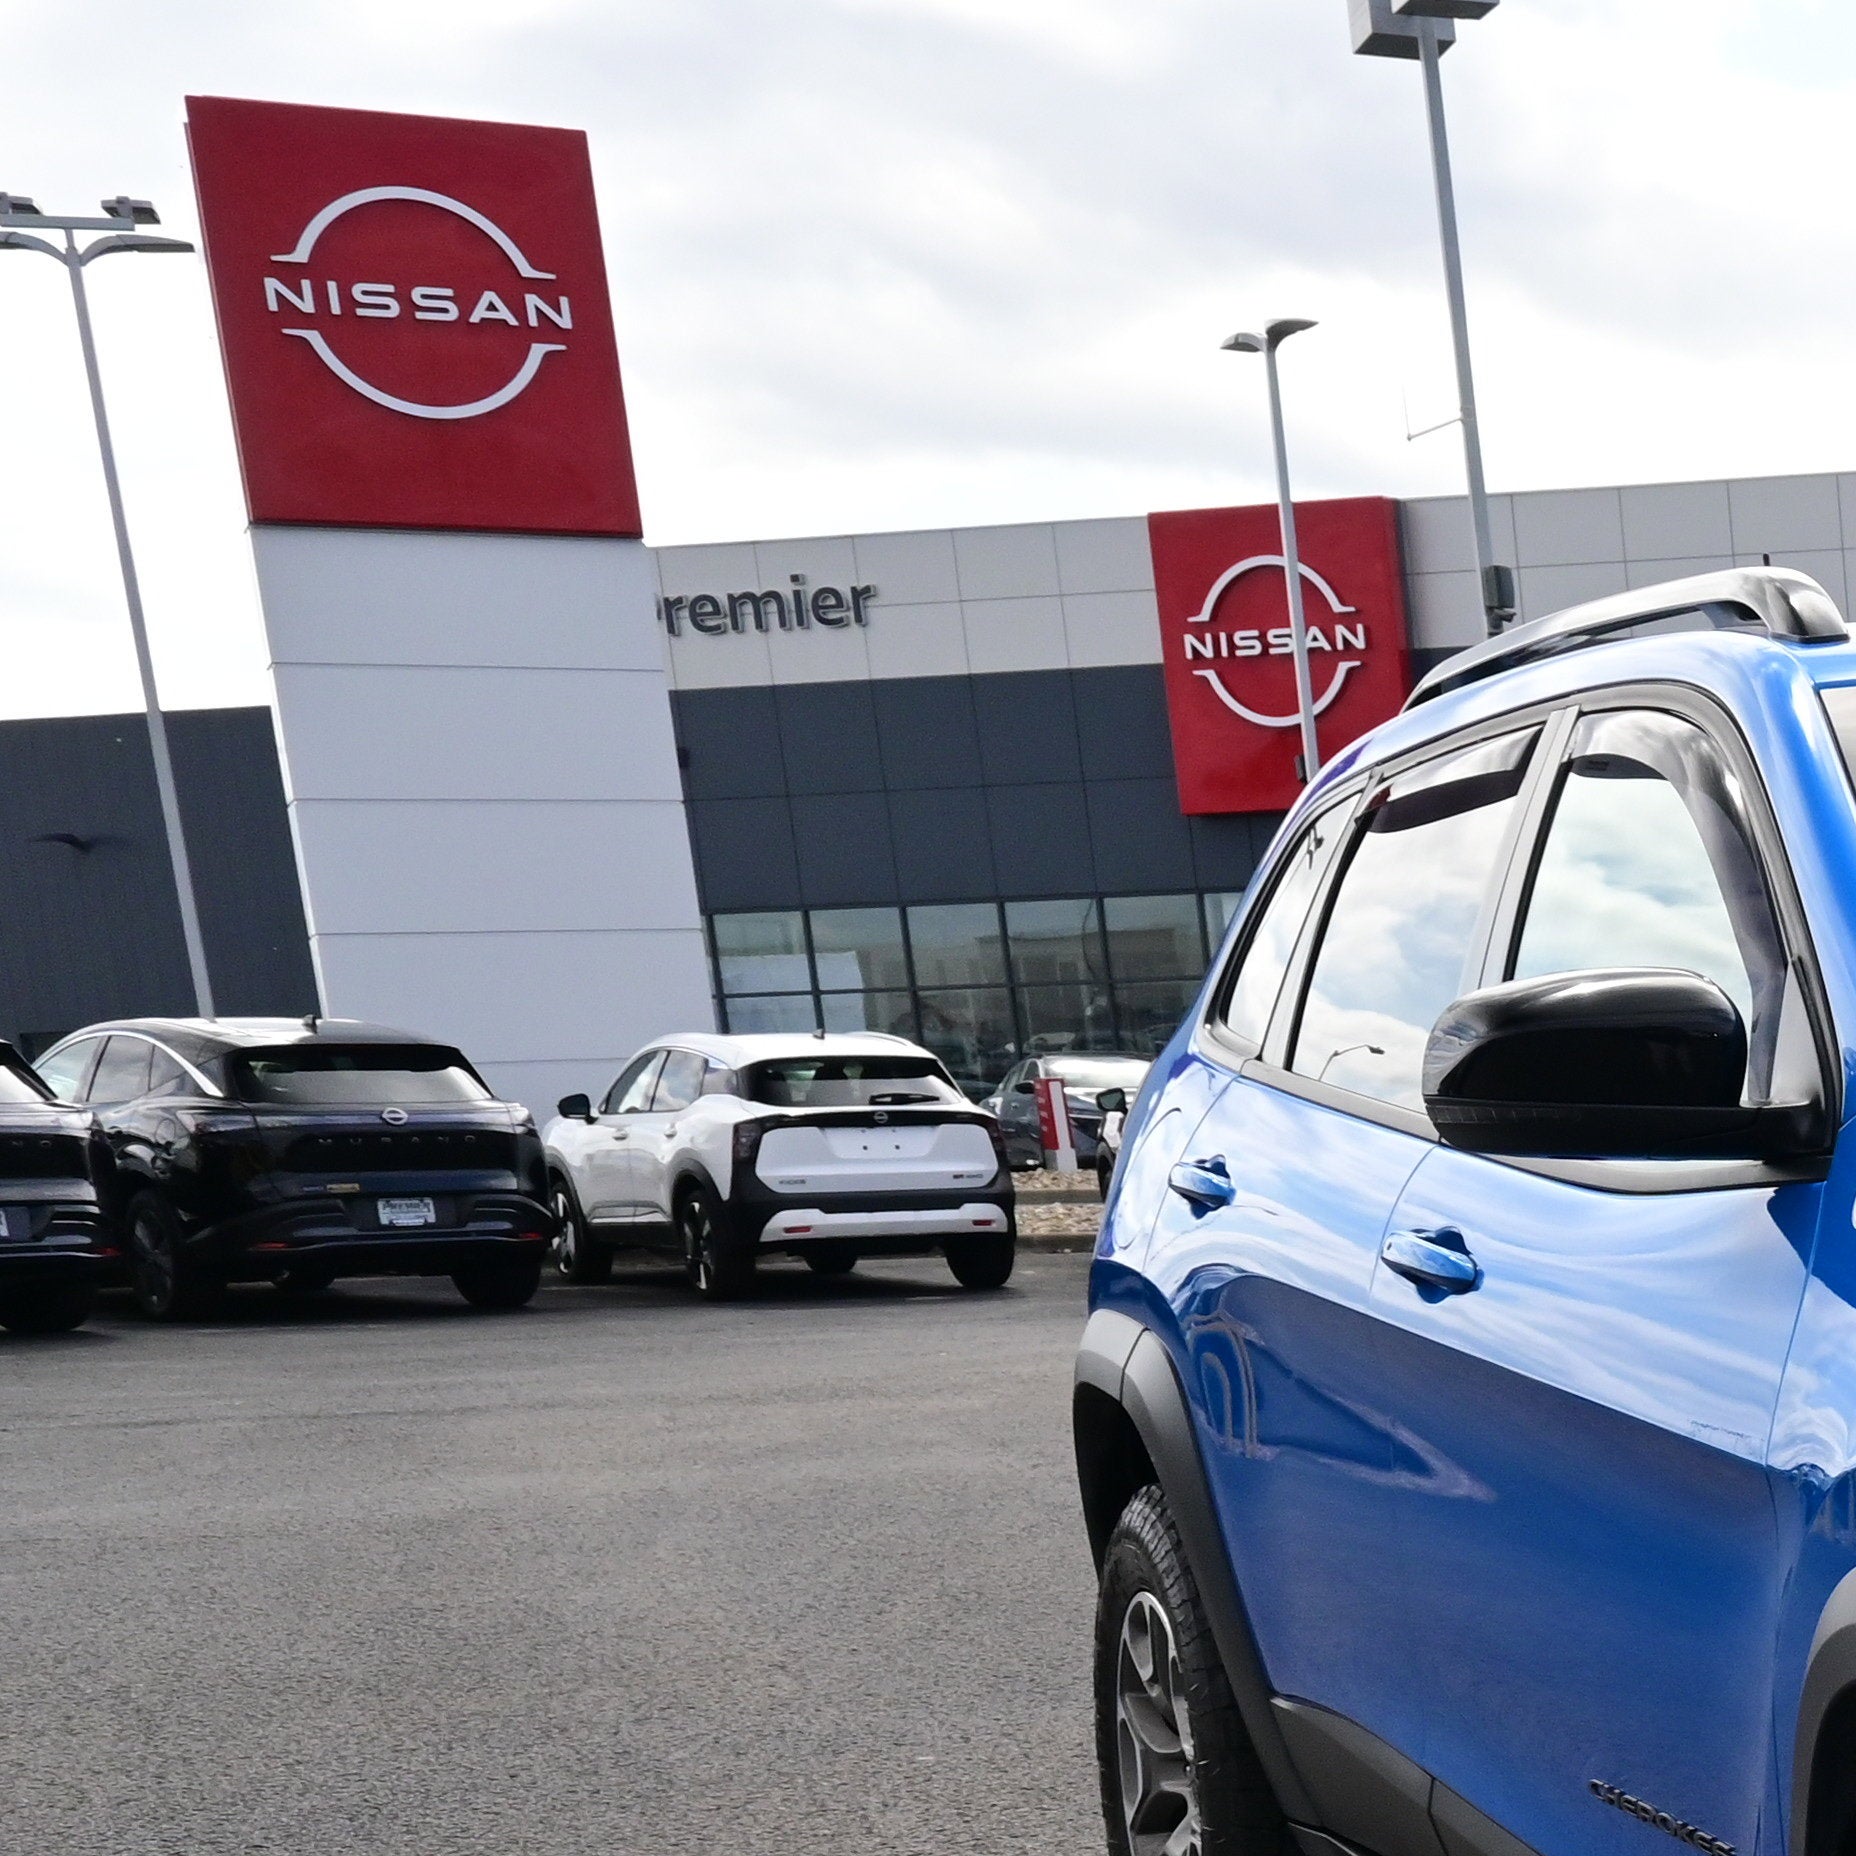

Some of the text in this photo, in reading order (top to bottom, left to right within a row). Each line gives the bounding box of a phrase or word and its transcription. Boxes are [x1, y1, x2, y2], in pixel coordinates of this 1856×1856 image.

[264, 277, 574, 331] NISSAN
[656, 573, 877, 637] remier
[1183, 623, 1366, 660] NISSAN
